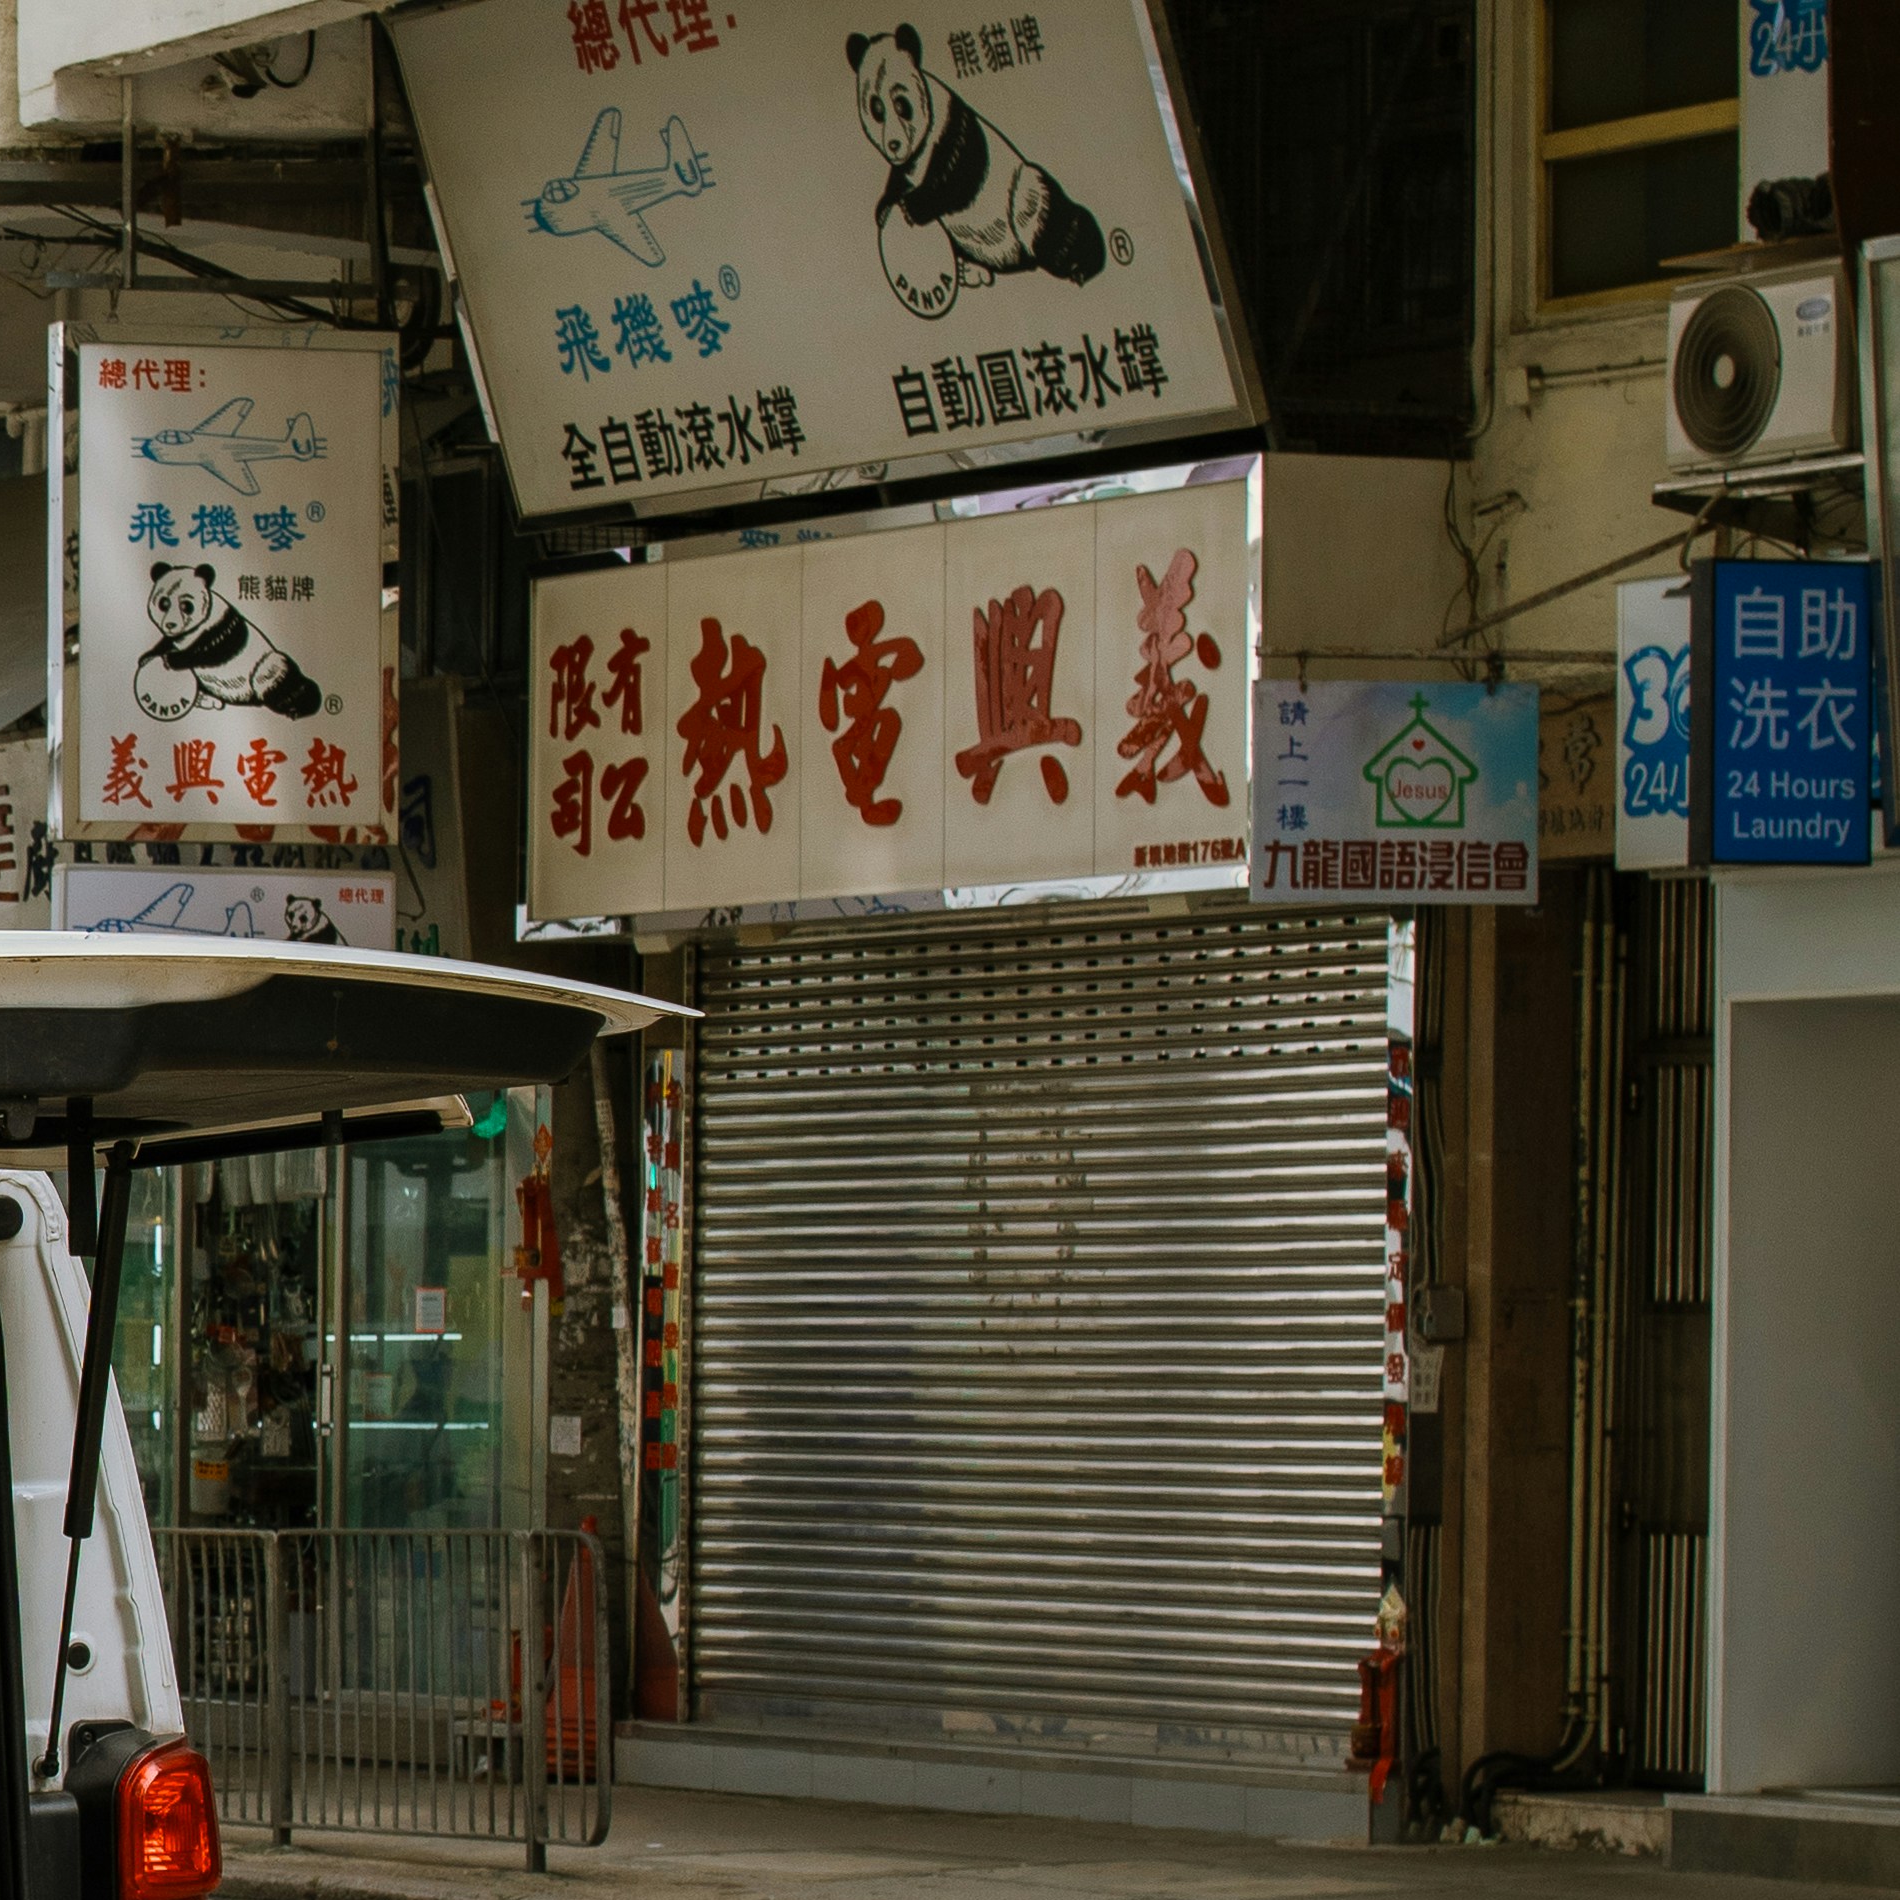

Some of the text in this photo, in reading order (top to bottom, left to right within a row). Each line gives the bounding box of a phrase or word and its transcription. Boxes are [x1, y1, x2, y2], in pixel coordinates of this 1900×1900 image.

[948, 14, 1045, 79] 熊貓牌
[896, 272, 954, 310] PANDA
[238, 574, 316, 602] 熊貓牌
[1735, 586, 1856, 660] 自助
[140, 692, 190, 717] PANDA
[1729, 677, 1856, 750] 洗衣
[102, 732, 359, 809] 義興電熱
[1278, 700, 1309, 831] 請上一樓
[1728, 770, 1856, 799] 24 Hours
[1391, 780, 1449, 800] Jesus
[1733, 811, 1851, 847] Laundry
[1264, 839, 1530, 890] 九龍國語浸信會
